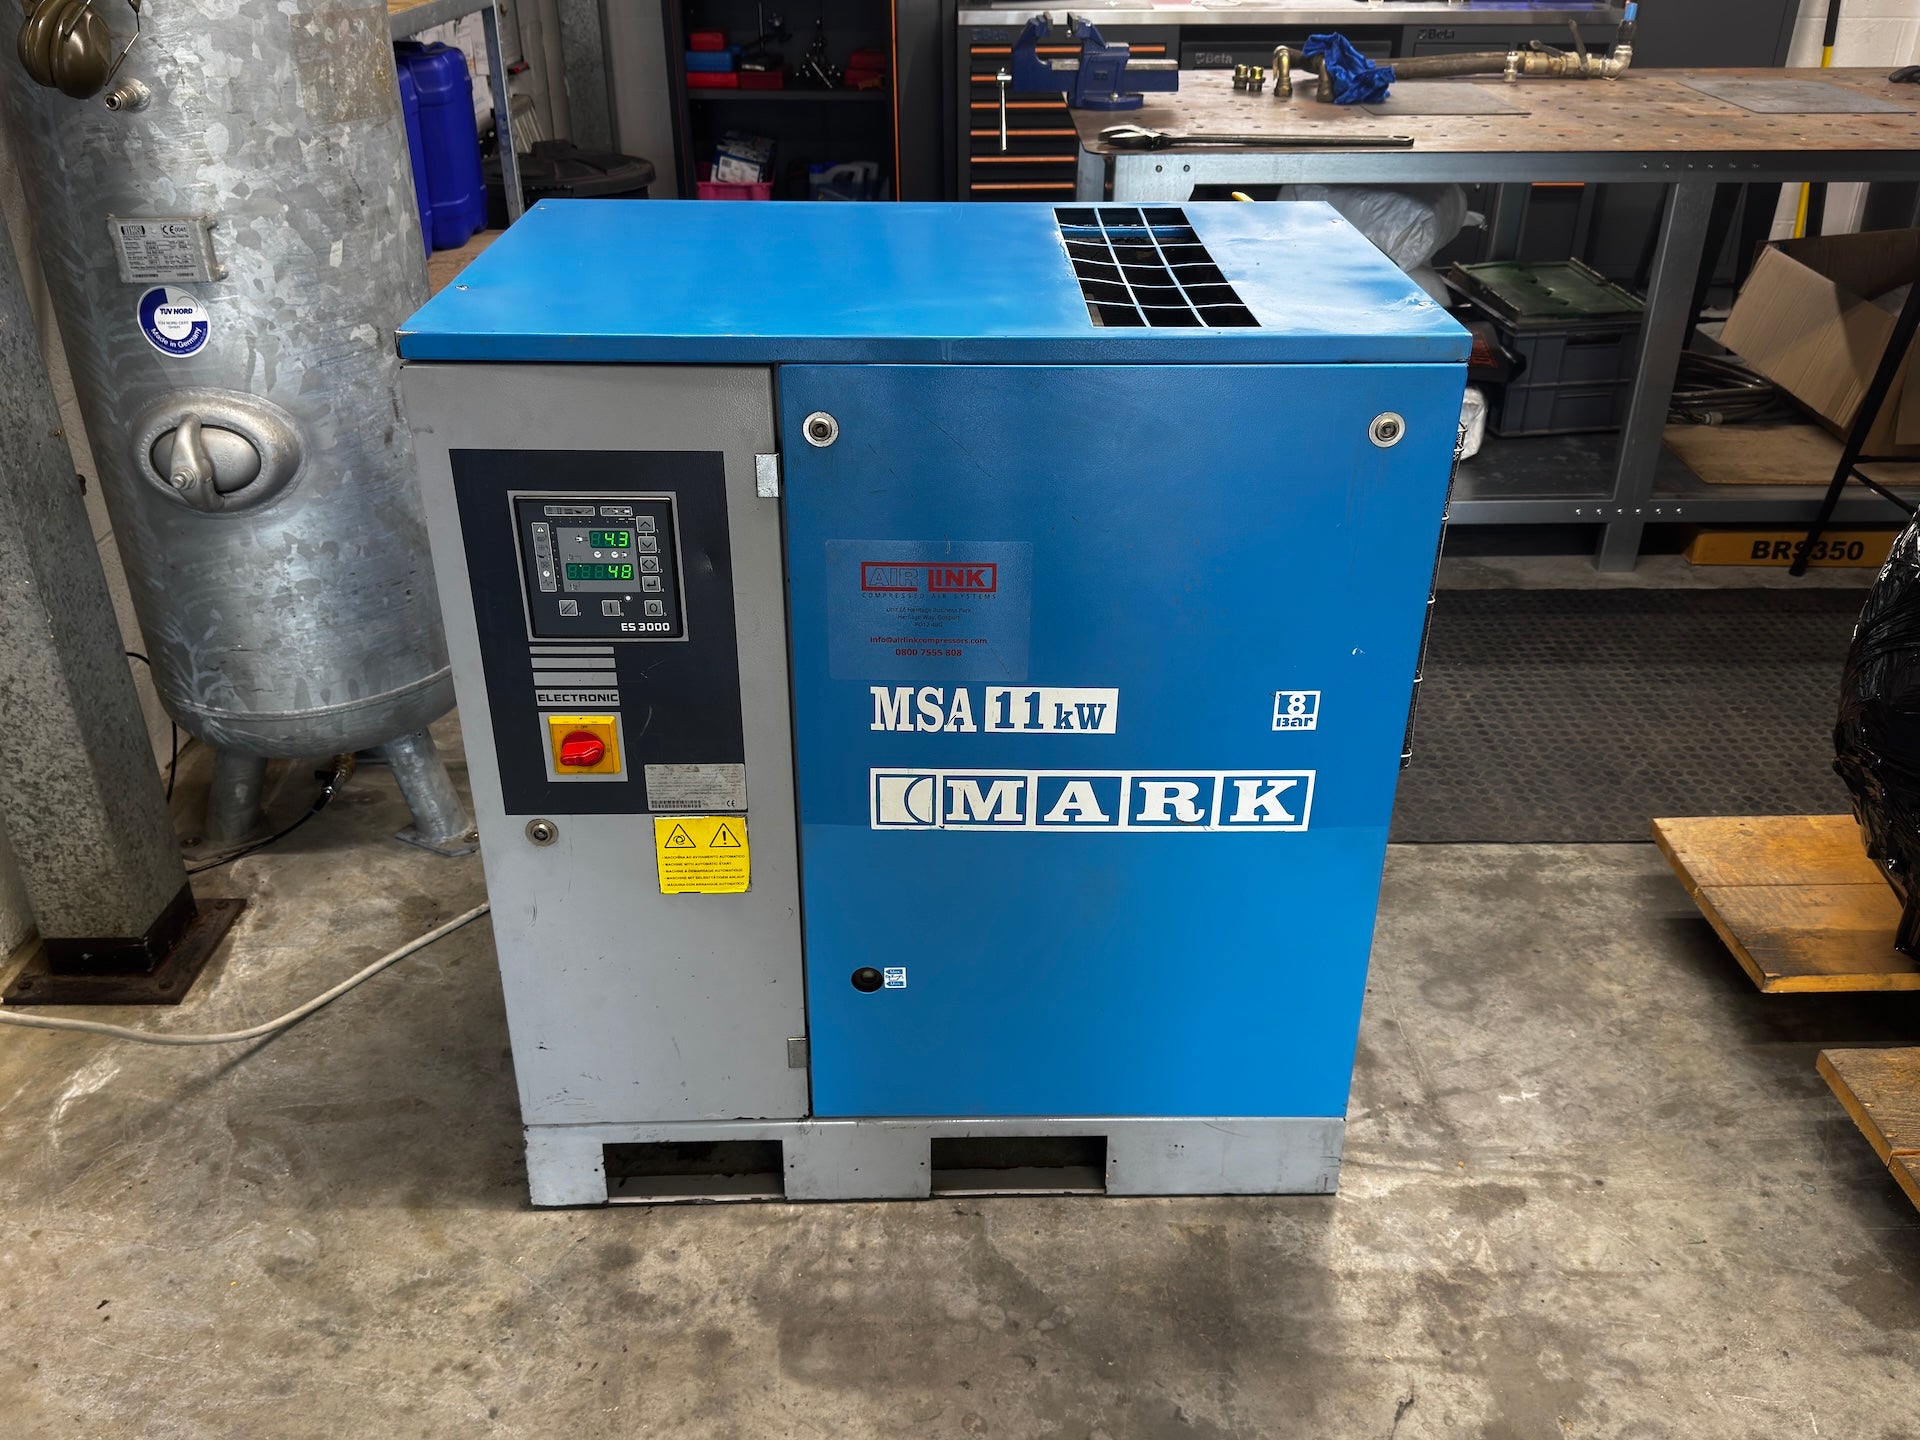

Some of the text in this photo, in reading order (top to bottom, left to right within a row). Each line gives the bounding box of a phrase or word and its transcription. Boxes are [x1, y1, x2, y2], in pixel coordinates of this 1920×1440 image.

[1429, 29, 1454, 40] Beta
[1206, 52, 1232, 64] Beta
[151, 328, 168, 345] Made
[178, 327, 202, 348] Germany
[604, 532, 629, 547] 4.3
[608, 565, 632, 578] 48
[869, 568, 986, 592] AIR LINK
[621, 622, 670, 631] ES 3000
[538, 694, 618, 702] ELECTRONIC
[1287, 694, 1306, 715] 8
[870, 686, 1107, 733] MSA 11 kW
[946, 780, 1298, 823] MARK
